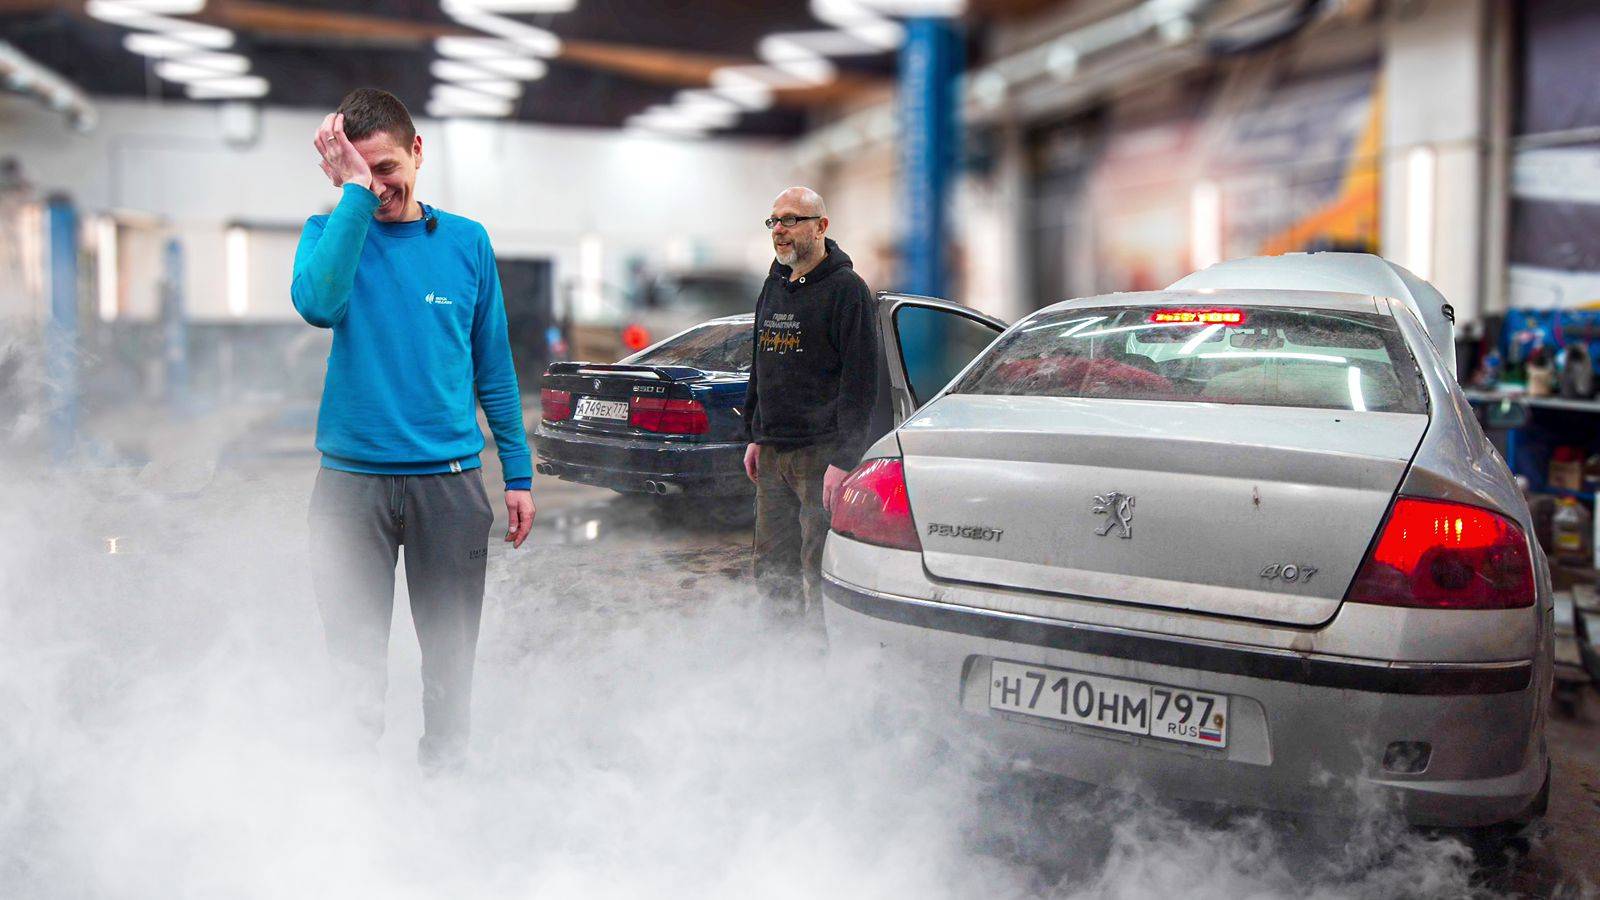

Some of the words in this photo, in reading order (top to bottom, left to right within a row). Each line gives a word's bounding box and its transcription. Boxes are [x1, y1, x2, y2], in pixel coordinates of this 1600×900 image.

[613, 402, 628, 414] 777
[927, 522, 1004, 542] PEUGEOT
[1260, 562, 1319, 584] 407
[1153, 690, 1215, 728] 797
[1167, 722, 1198, 738] RUS
